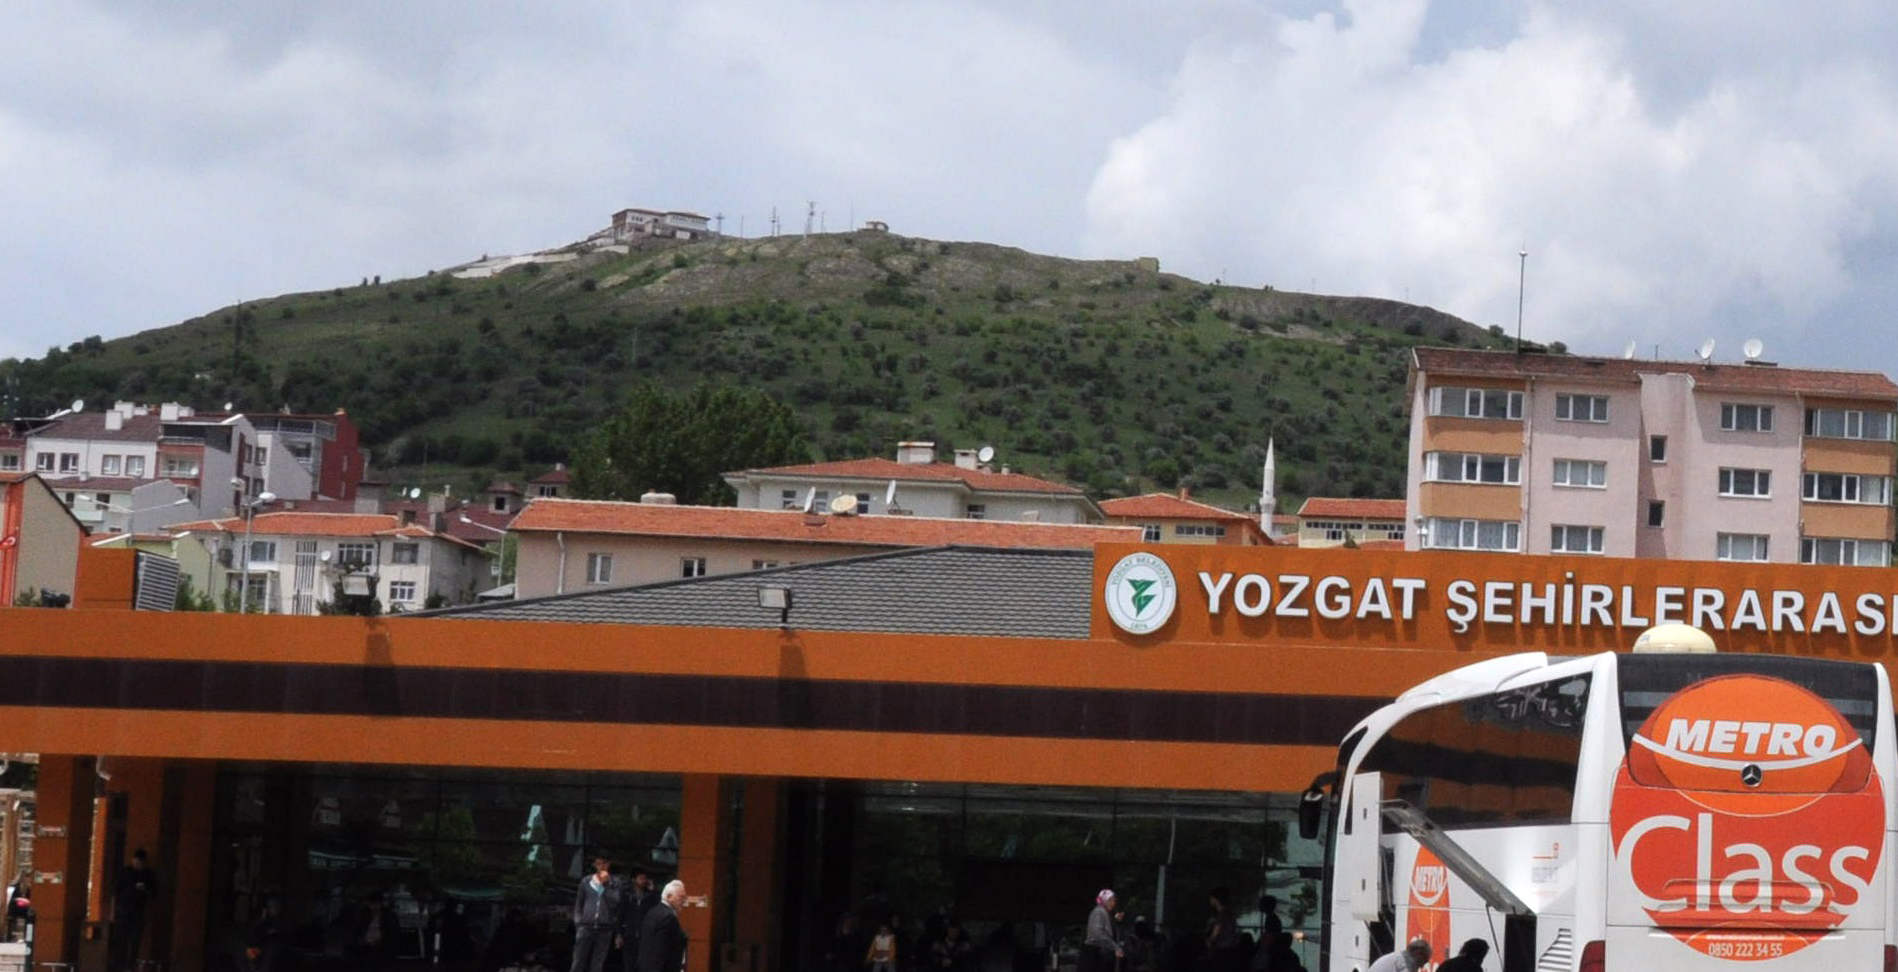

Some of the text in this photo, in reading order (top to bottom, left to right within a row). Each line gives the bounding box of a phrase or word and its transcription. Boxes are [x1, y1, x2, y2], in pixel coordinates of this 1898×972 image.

[1198, 571, 1426, 620] YOZGAT
[1664, 718, 1837, 757] METRO
[1617, 812, 1870, 914] Class
[1708, 942, 1783, 957] 0850 222 34 55
